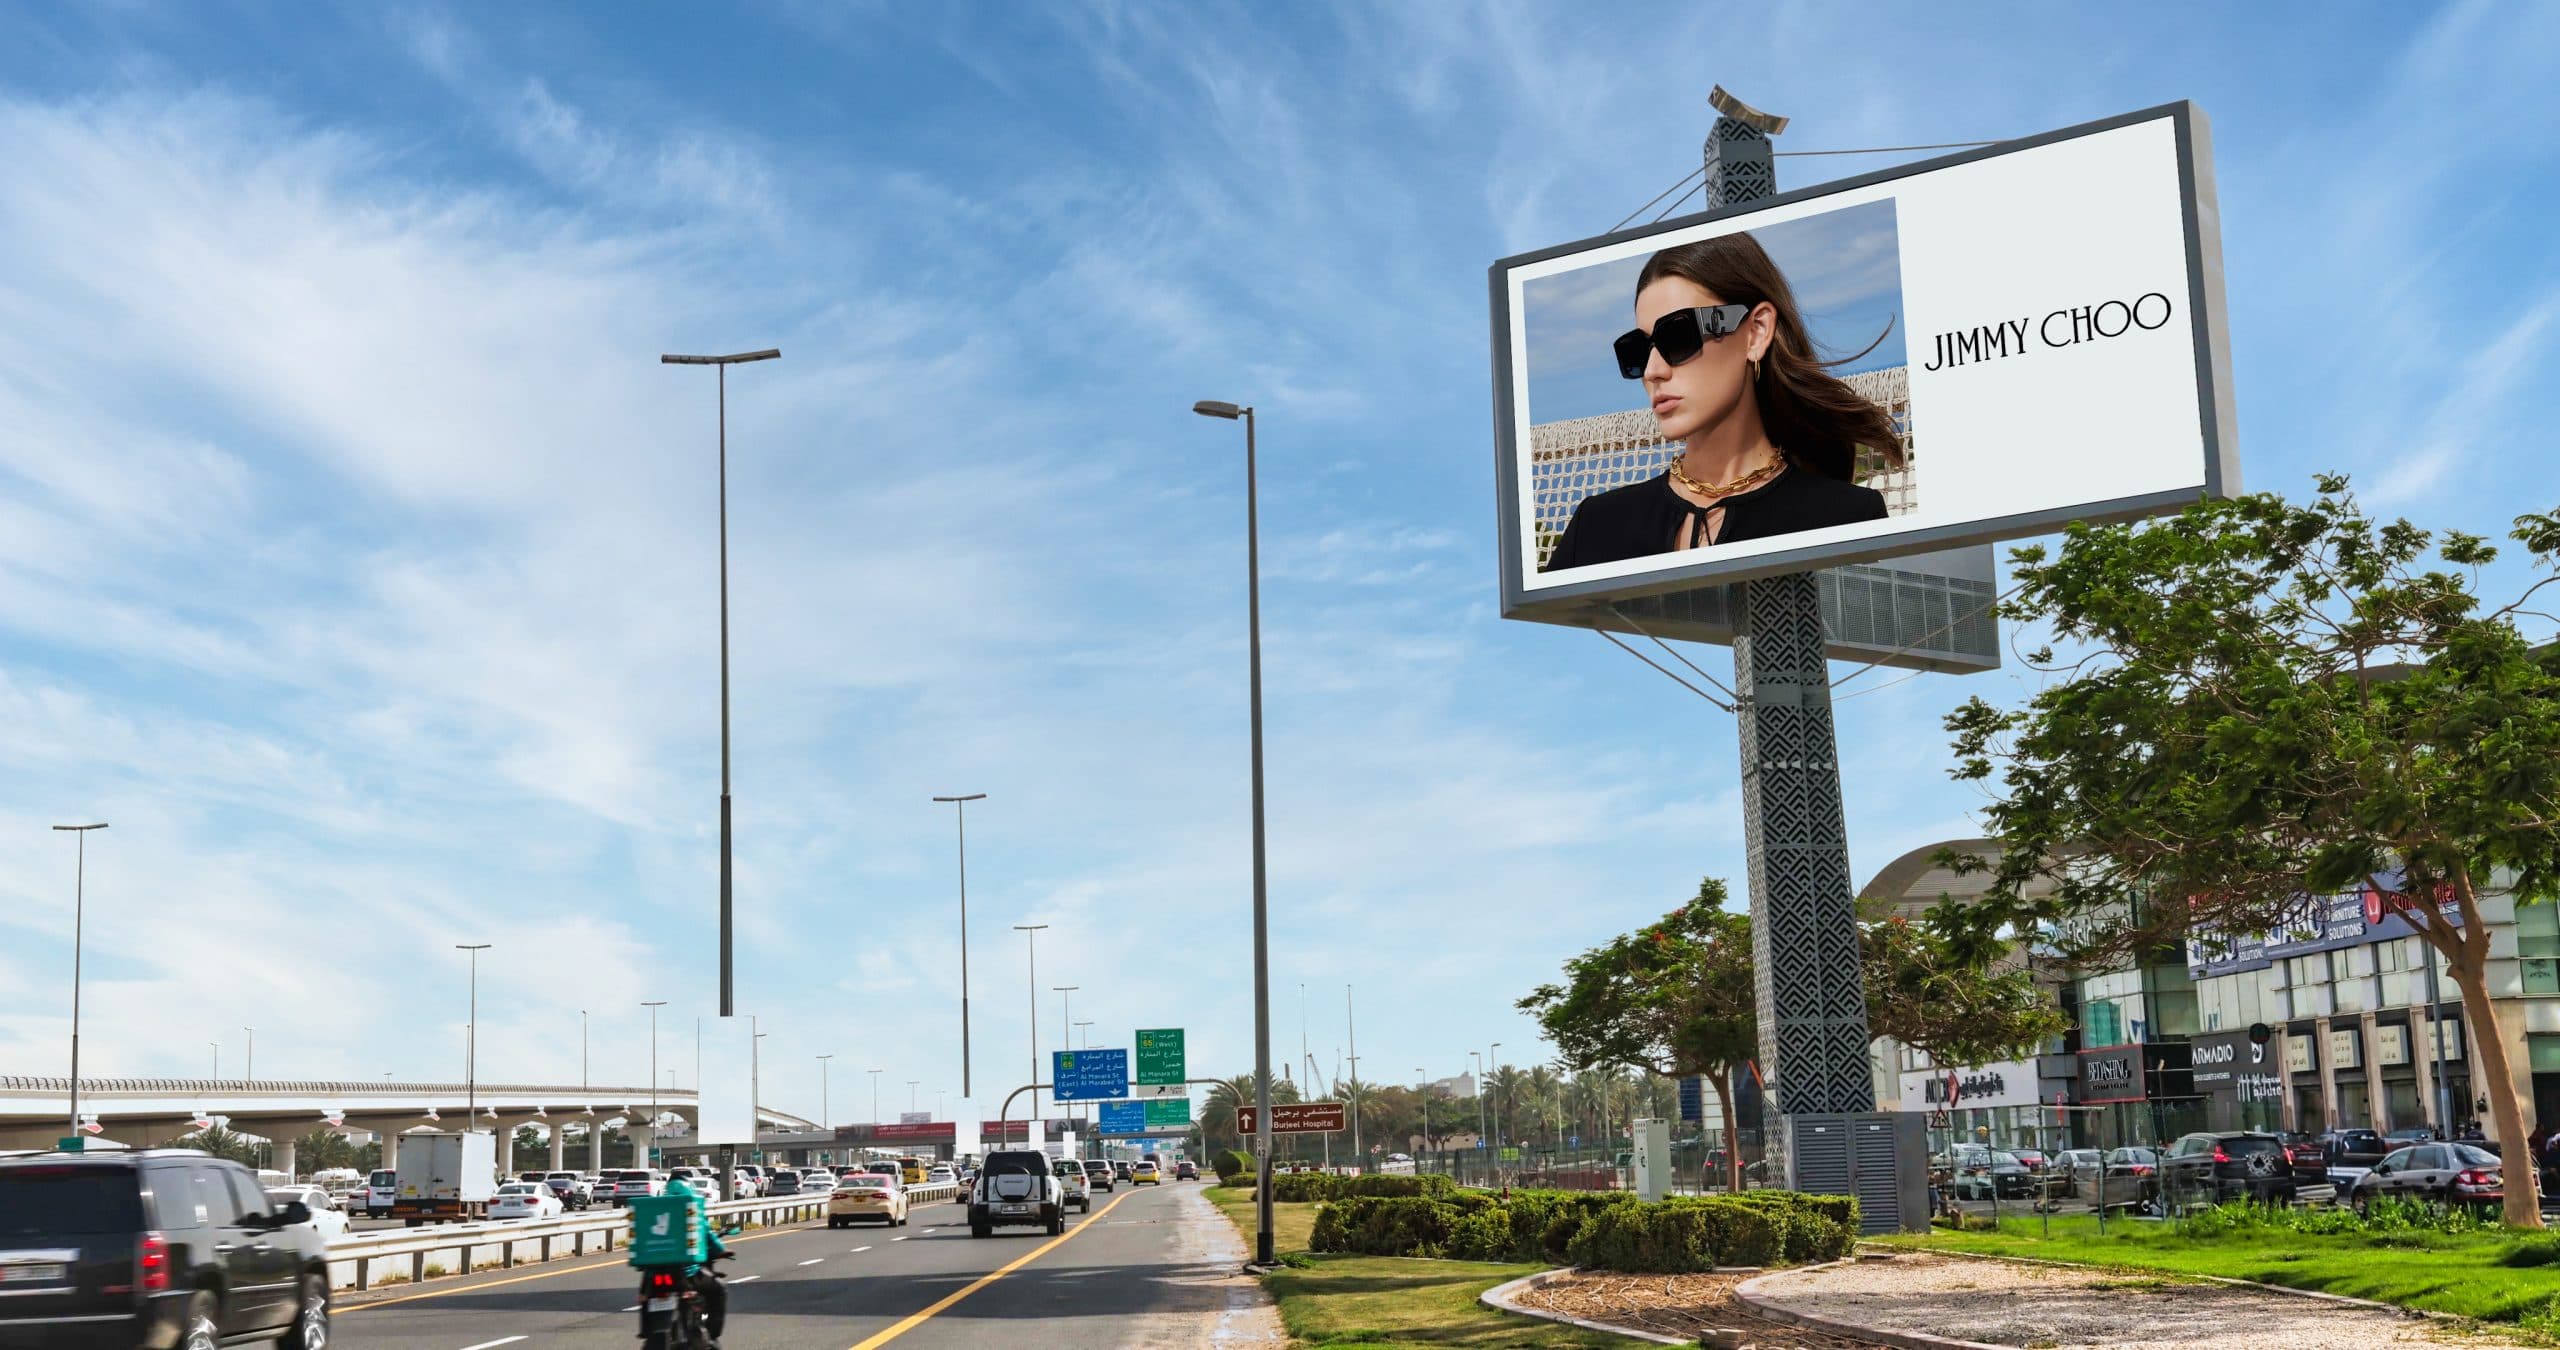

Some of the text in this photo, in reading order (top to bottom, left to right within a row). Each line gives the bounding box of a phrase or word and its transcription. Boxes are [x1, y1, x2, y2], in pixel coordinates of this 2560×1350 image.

[1924, 292, 2172, 371] JIMMY CHOO
[2328, 923, 2363, 941] SOLUTIONS
[2192, 1043, 2233, 1065] ARMADIO
[1273, 1106, 1342, 1119] مستشفى برجيل
[1273, 1119, 1334, 1129] Burjeel Hospital
